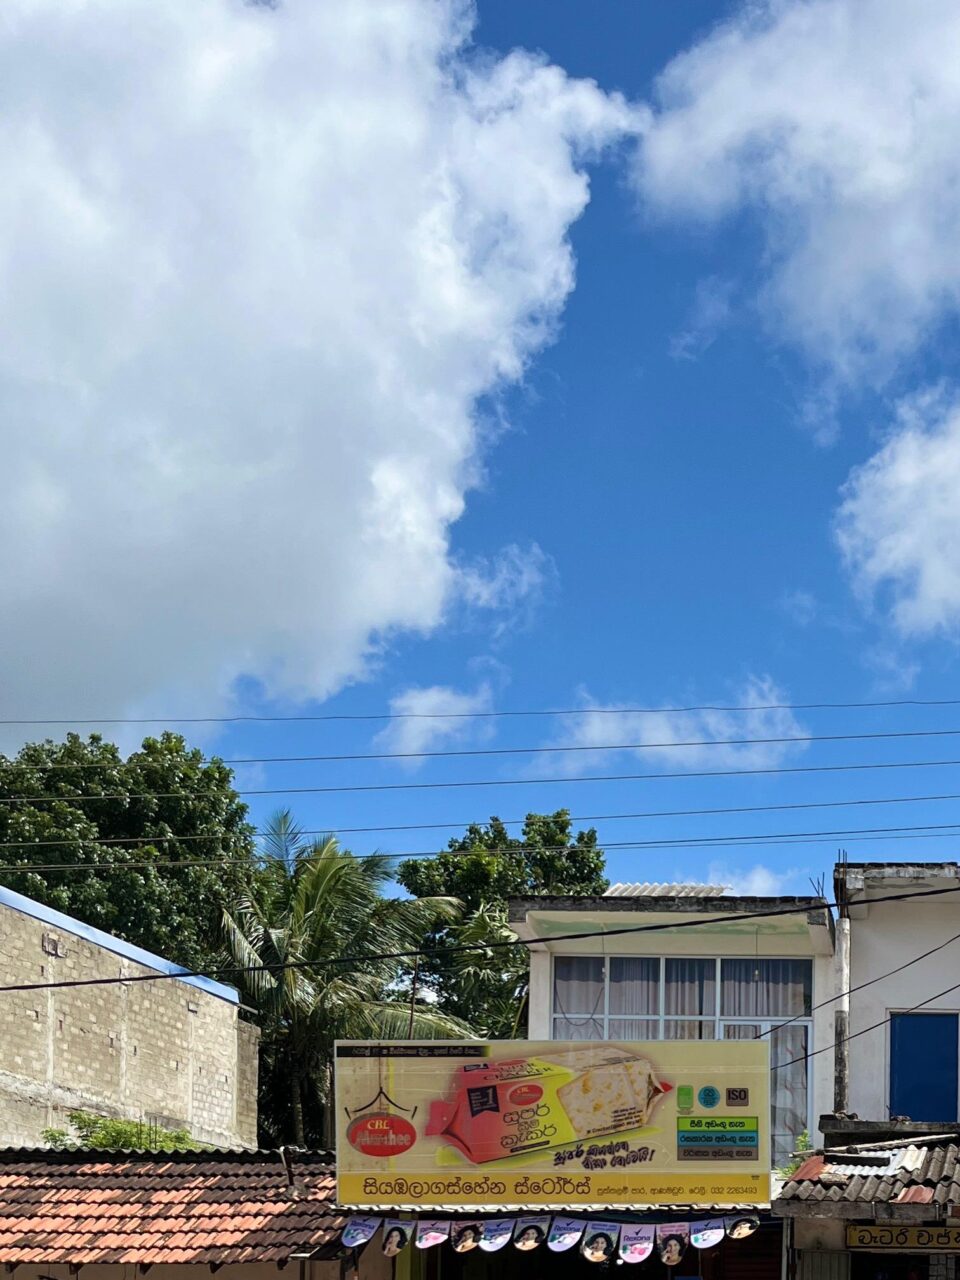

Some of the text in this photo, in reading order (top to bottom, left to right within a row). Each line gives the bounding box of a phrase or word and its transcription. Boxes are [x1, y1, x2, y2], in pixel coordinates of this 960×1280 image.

[728, 1089, 747, 1101] ISO
[367, 1120, 390, 1130] CBL
[710, 1186, 725, 1195] 032
[554, 1224, 581, 1233] Rexona
[858, 1227, 909, 1246] බැටරි
